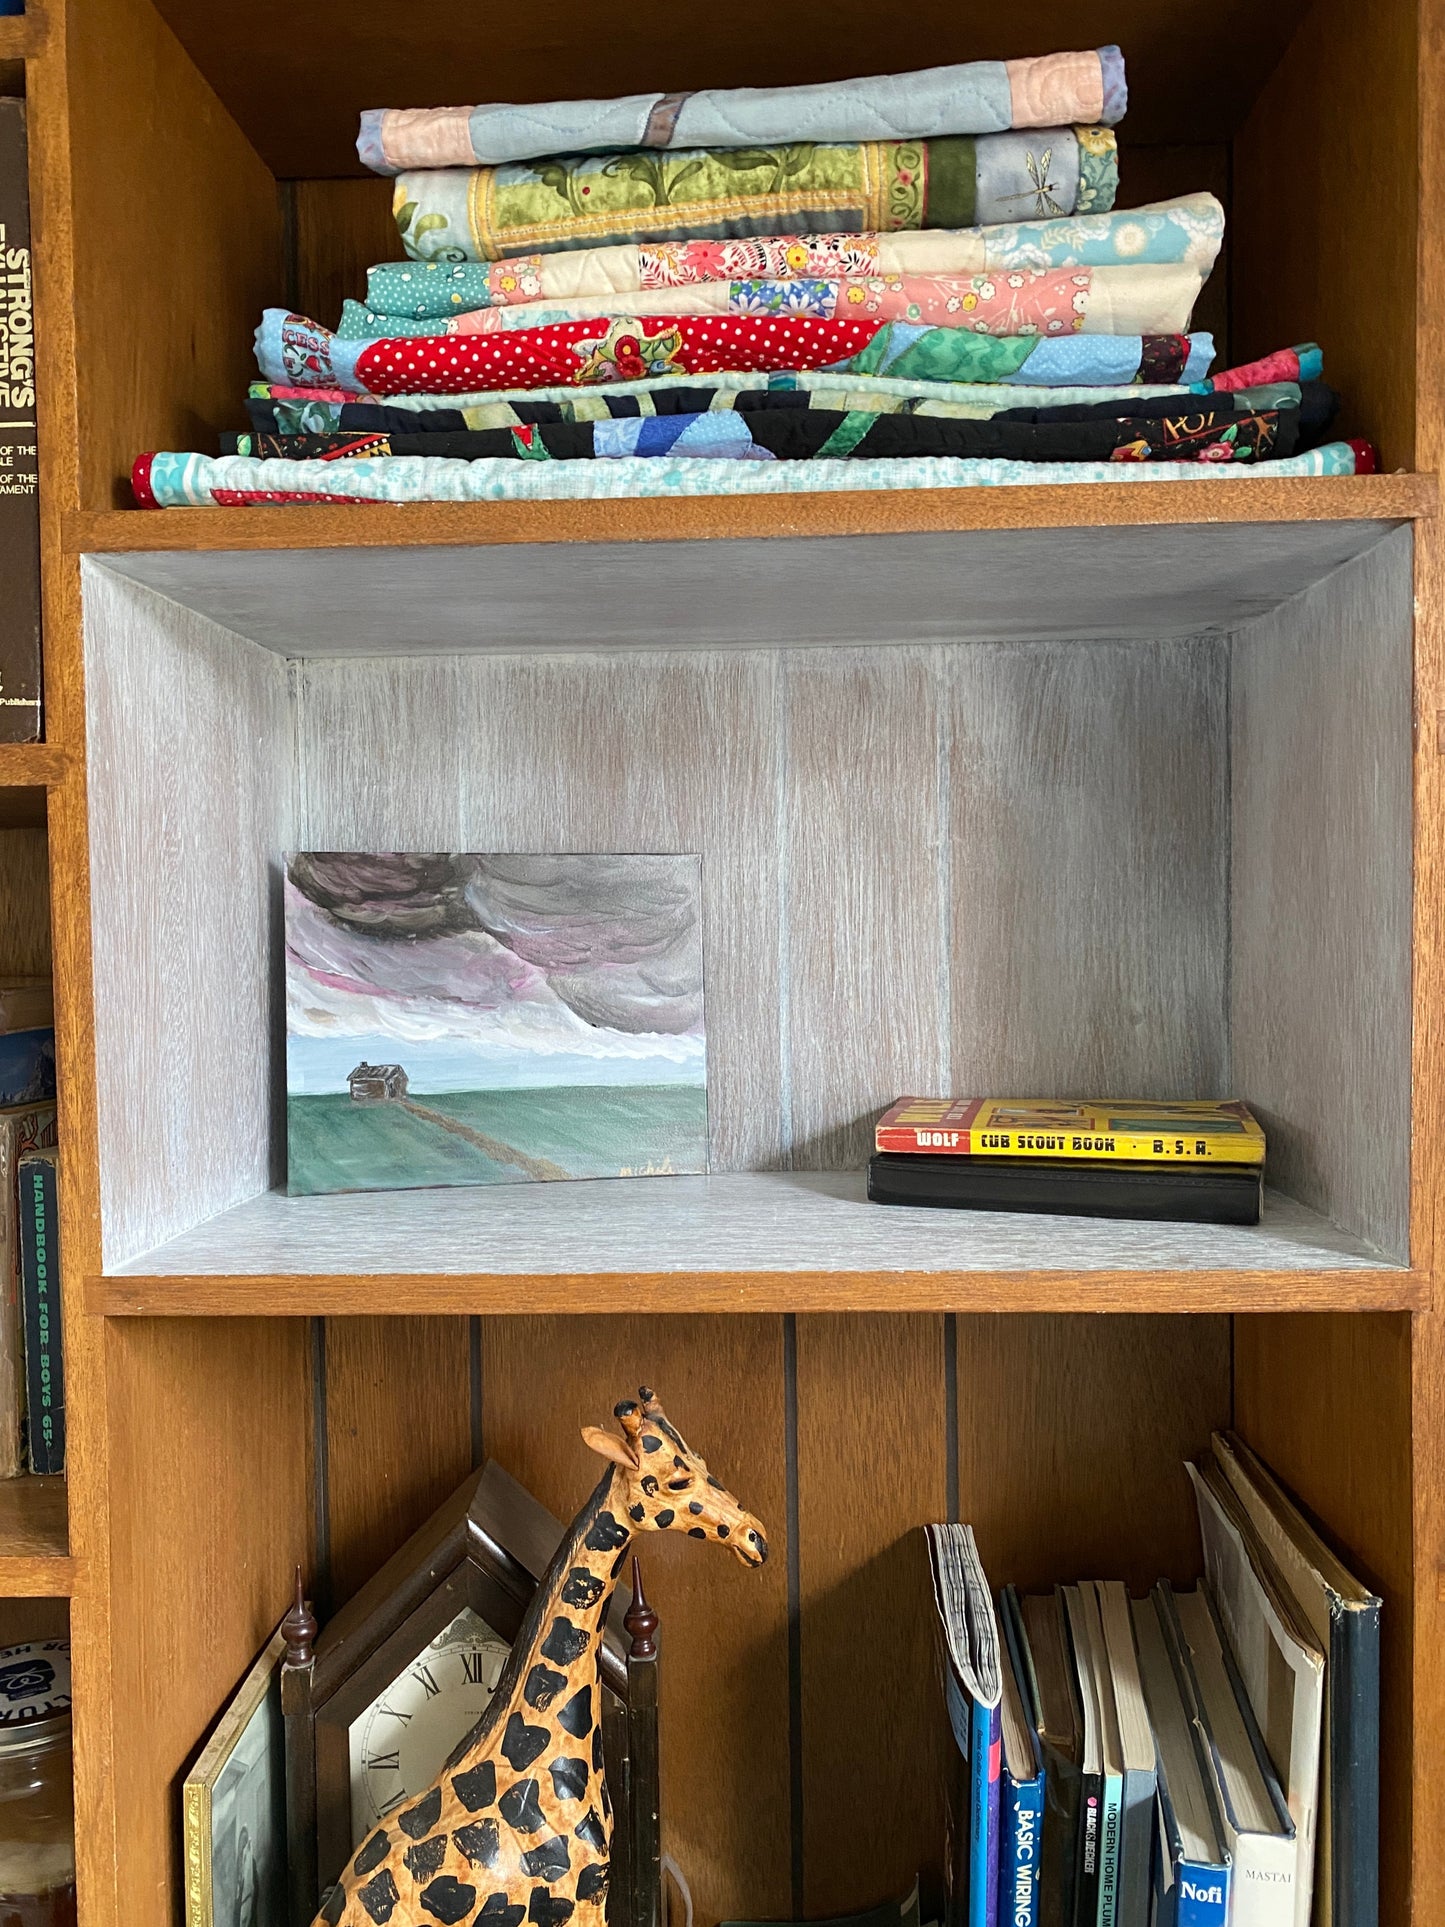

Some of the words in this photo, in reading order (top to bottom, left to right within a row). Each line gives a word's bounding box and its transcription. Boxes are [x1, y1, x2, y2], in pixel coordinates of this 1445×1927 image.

[6, 248, 35, 409] STRONG'S
[0, 446, 14, 455] OF
[17, 446, 37, 455] THE
[0, 474, 14, 483] OF
[17, 474, 38, 483] THE
[0, 485, 35, 494] AMENT
[917, 1133, 959, 1147] WOLF
[981, 1135, 1010, 1148] CUB
[1018, 1135, 1065, 1150] SCOUT
[1073, 1137, 1115, 1152] BOOK
[33, 1175, 48, 1294] HANDBOOK
[38, 1303, 49, 1344] FOR
[40, 1354, 51, 1407] BOYS
[412, 1665, 442, 1700] XI
[459, 1653, 484, 1685] XII
[379, 1702, 414, 1728] X
[1016, 1810, 1034, 1860] BASIC
[1105, 1803, 1117, 1854] MODERN
[1103, 1857, 1115, 1892] HOME
[1245, 1869, 1292, 1883] MASTAI
[1014, 1864, 1032, 1927] WIRING
[1181, 1881, 1222, 1904] Nofi
